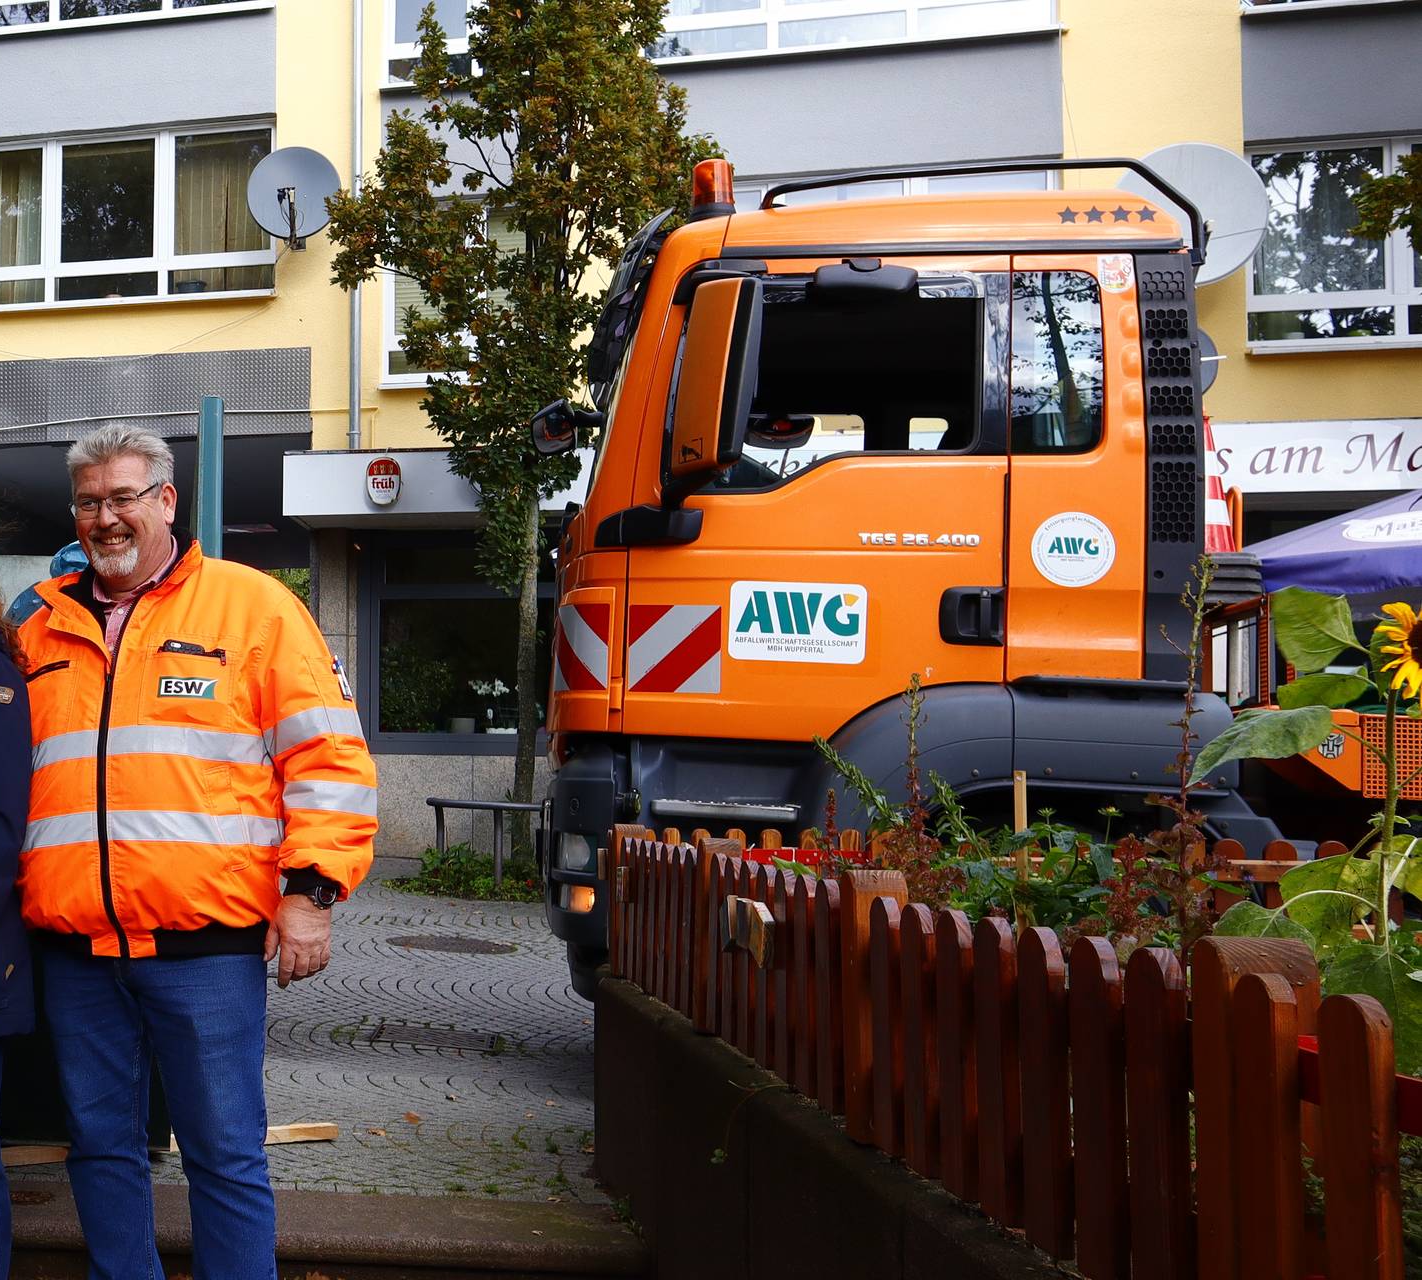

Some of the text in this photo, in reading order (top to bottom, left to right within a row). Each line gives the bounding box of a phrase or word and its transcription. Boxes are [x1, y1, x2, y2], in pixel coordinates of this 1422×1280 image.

[1249, 445, 1325, 475] am
[371, 477, 395, 489] früh
[858, 532, 980, 546] TGS 26.400
[1048, 536, 1100, 556] AWG
[735, 590, 860, 636] AWG
[734, 636, 859, 648] ABFALLWIRTSCHAFTSGESELLSCHAFT
[784, 645, 825, 654] WUPPERTAL
[164, 680, 204, 694] ESW
